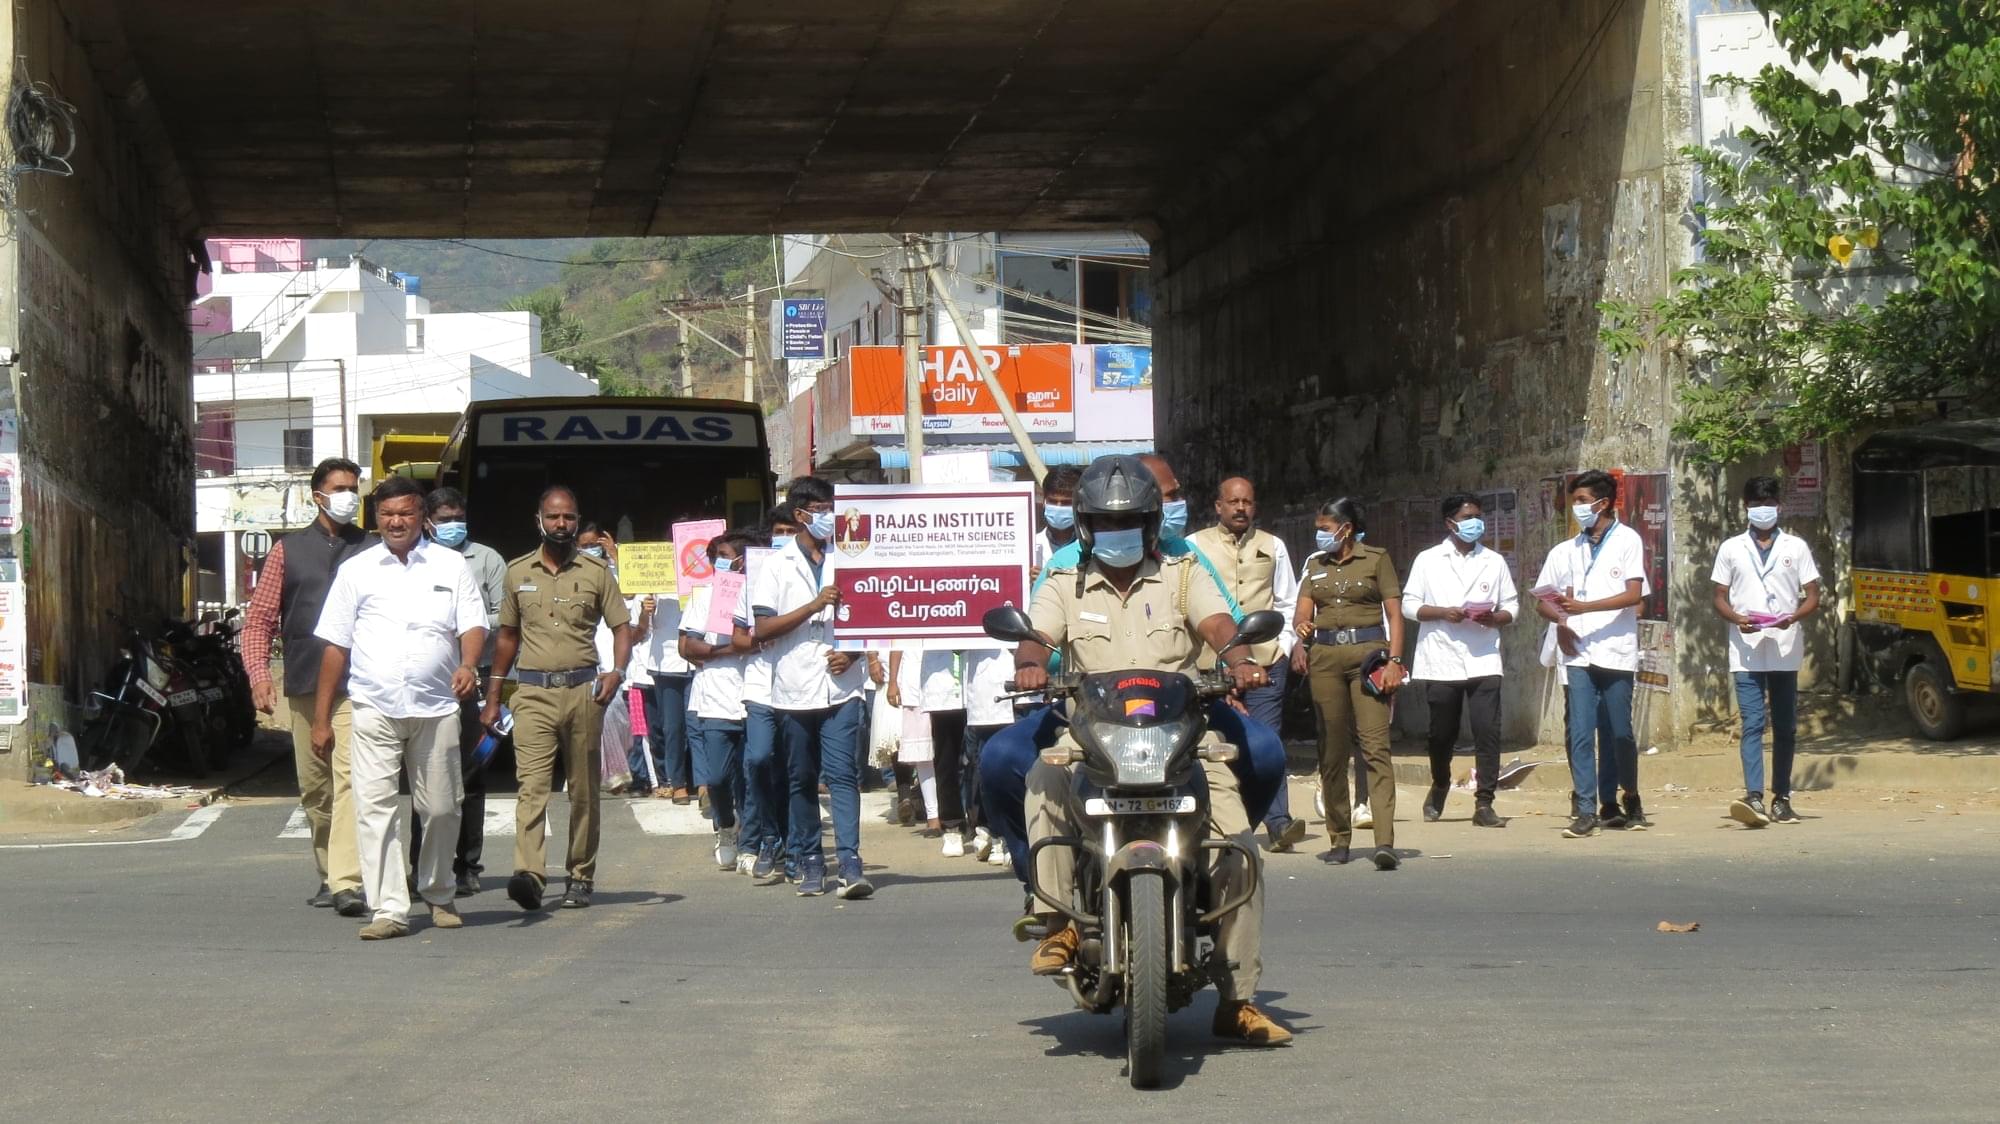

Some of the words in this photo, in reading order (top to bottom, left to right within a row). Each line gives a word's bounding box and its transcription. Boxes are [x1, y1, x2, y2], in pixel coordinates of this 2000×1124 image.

[919, 349, 1001, 383] HAP
[932, 382, 978, 406] daily
[503, 416, 733, 442] RAJAS
[875, 513, 927, 529] RAJAS
[933, 511, 1015, 528] INSTITUTE
[875, 533, 887, 543] OF
[890, 532, 924, 543] ALLIED
[927, 531, 965, 542] HEALTH
[967, 530, 1016, 542] SCIENCES
[854, 574, 1000, 598] விழிப்புணர்வு
[888, 600, 967, 621] பேரணி
[1128, 800, 1142, 810] 72
